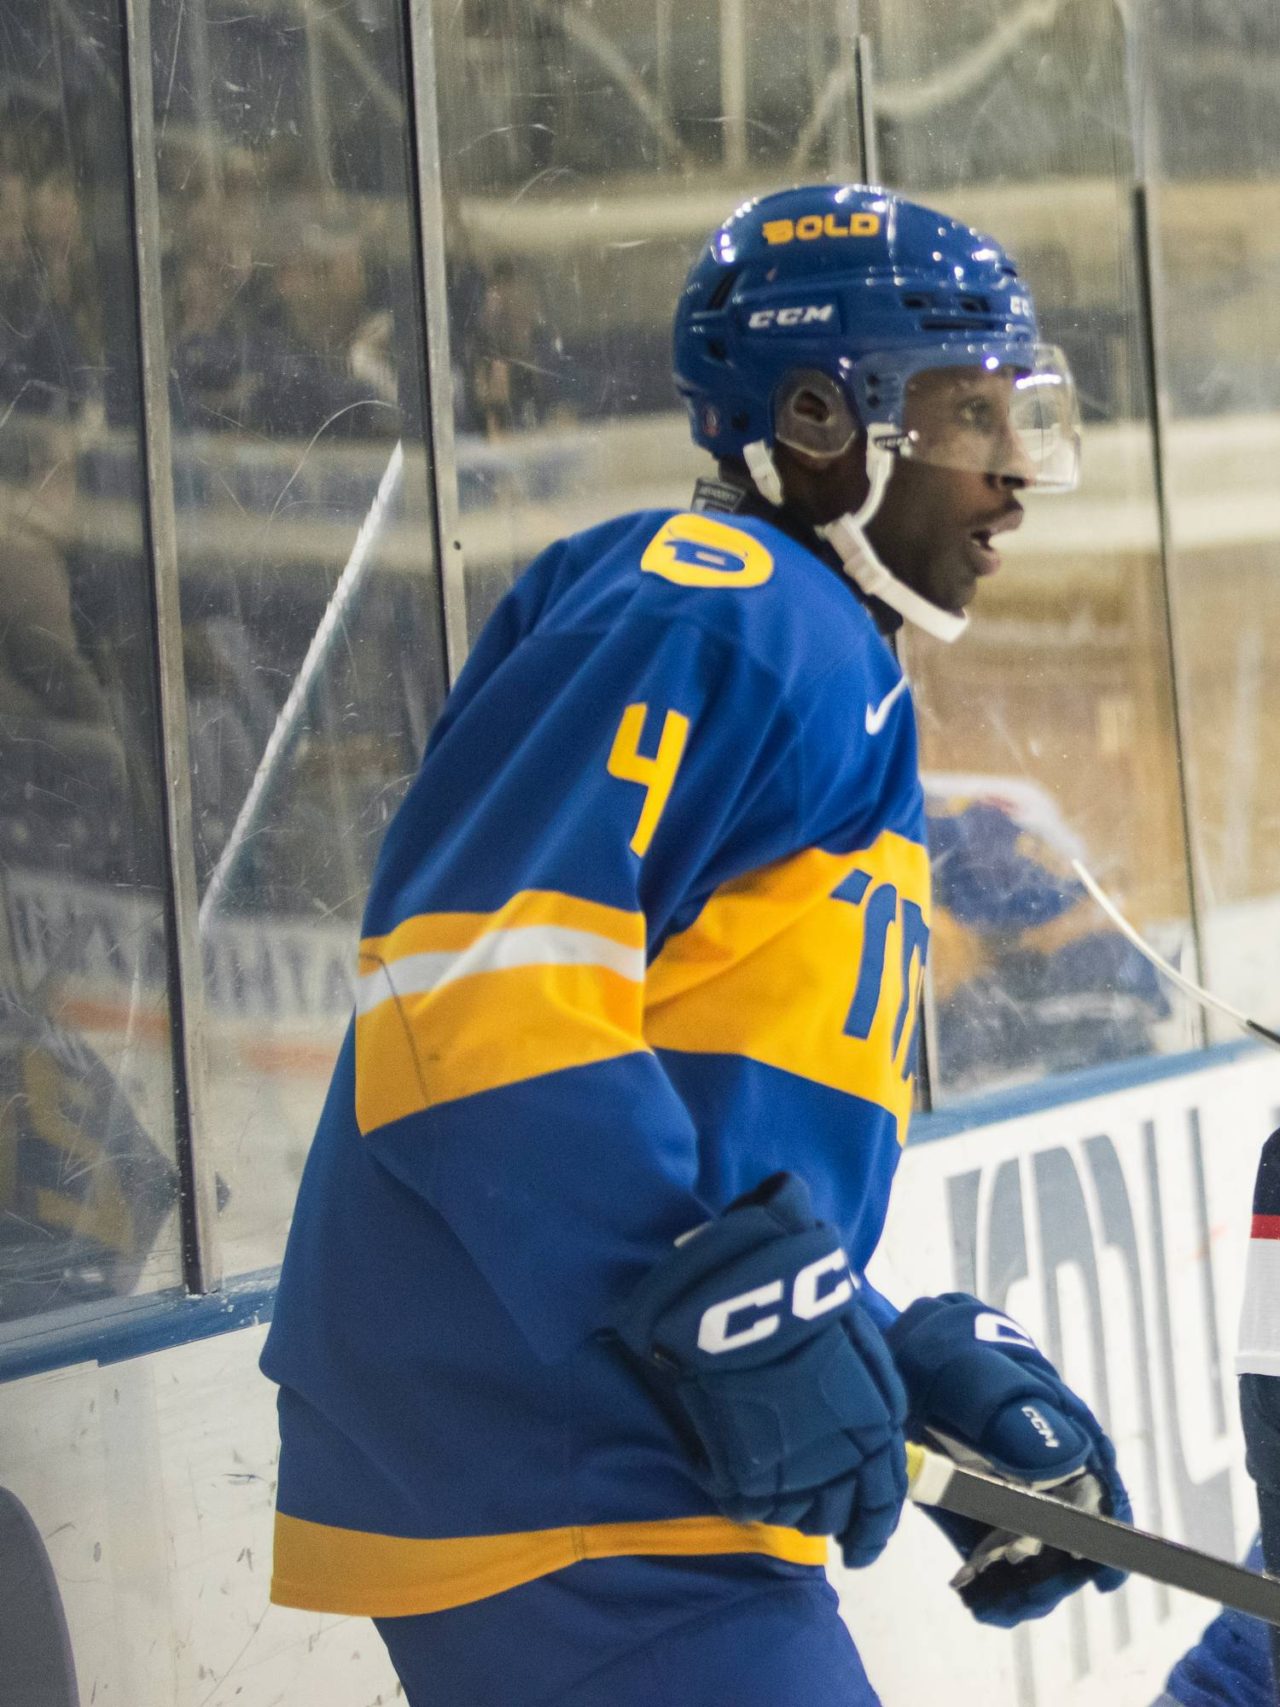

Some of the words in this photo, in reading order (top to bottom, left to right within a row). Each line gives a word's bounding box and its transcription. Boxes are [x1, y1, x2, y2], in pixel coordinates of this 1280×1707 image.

[762, 212, 880, 245] BOLD
[748, 303, 834, 329] CCM
[607, 702, 690, 859] 4
[697, 1247, 862, 1355] CC
[1021, 1405, 1059, 1448] CCM
